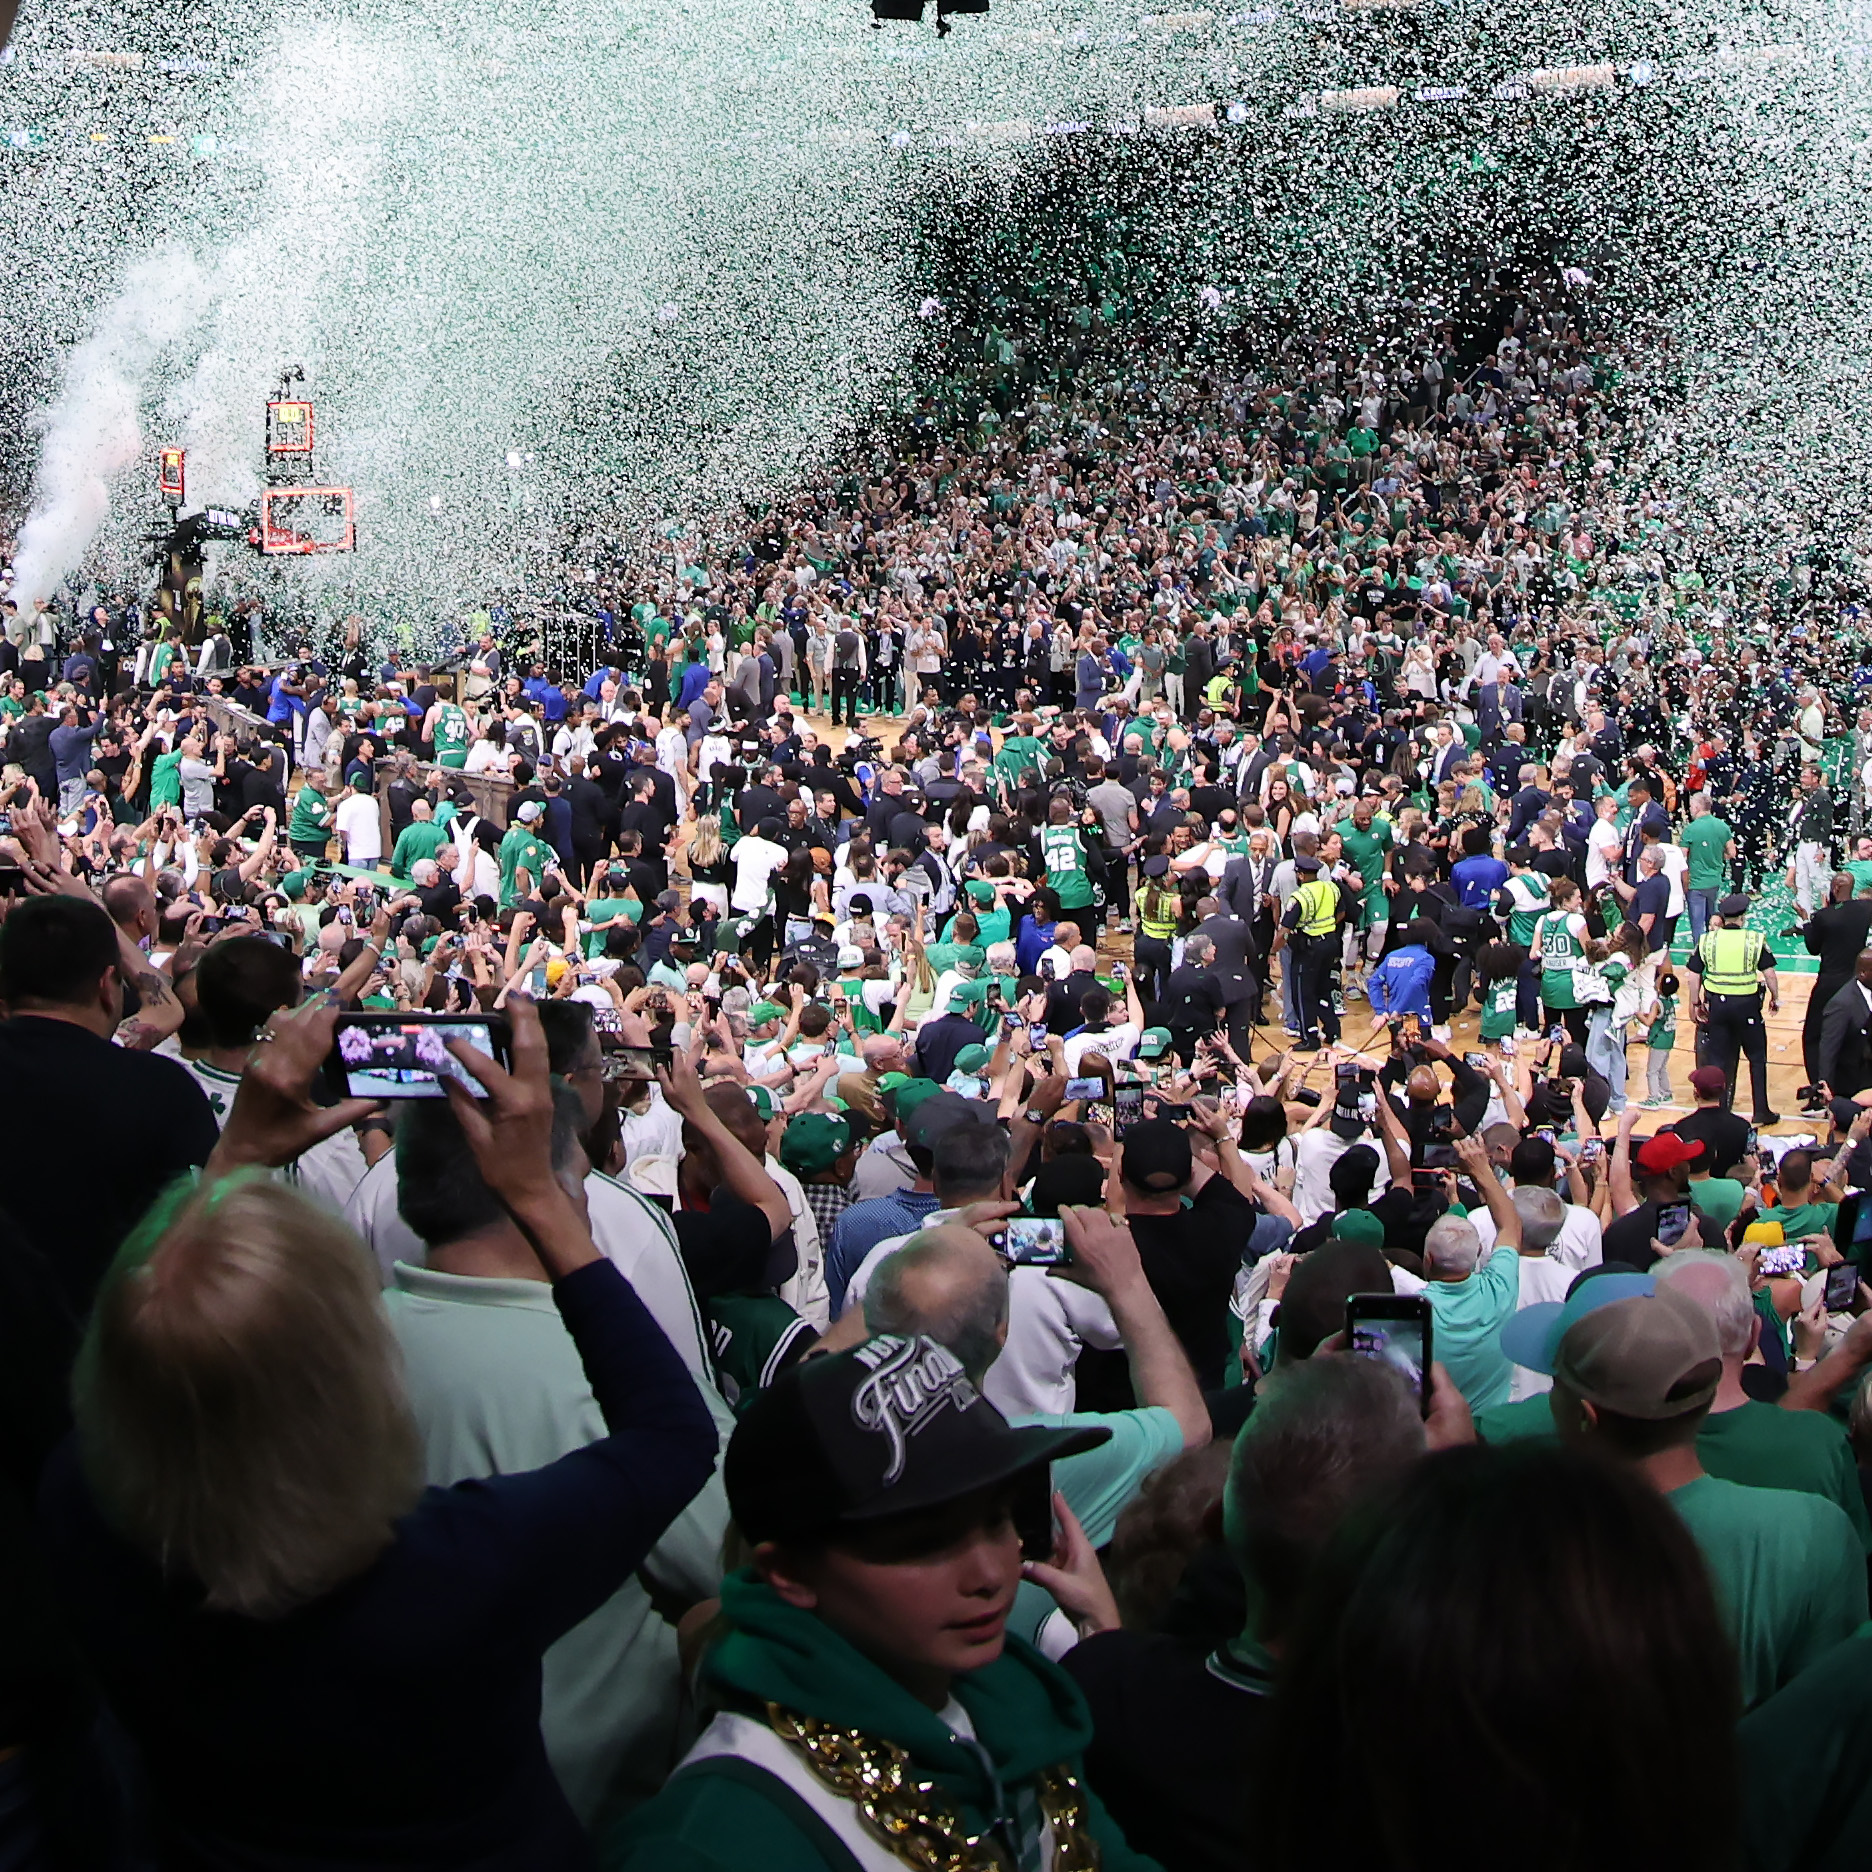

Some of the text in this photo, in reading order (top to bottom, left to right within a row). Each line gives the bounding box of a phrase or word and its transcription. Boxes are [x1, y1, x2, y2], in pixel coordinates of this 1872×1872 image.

[1044, 846, 1077, 873] 42
[1542, 931, 1572, 957] 30
[852, 1333, 907, 1371] NBA
